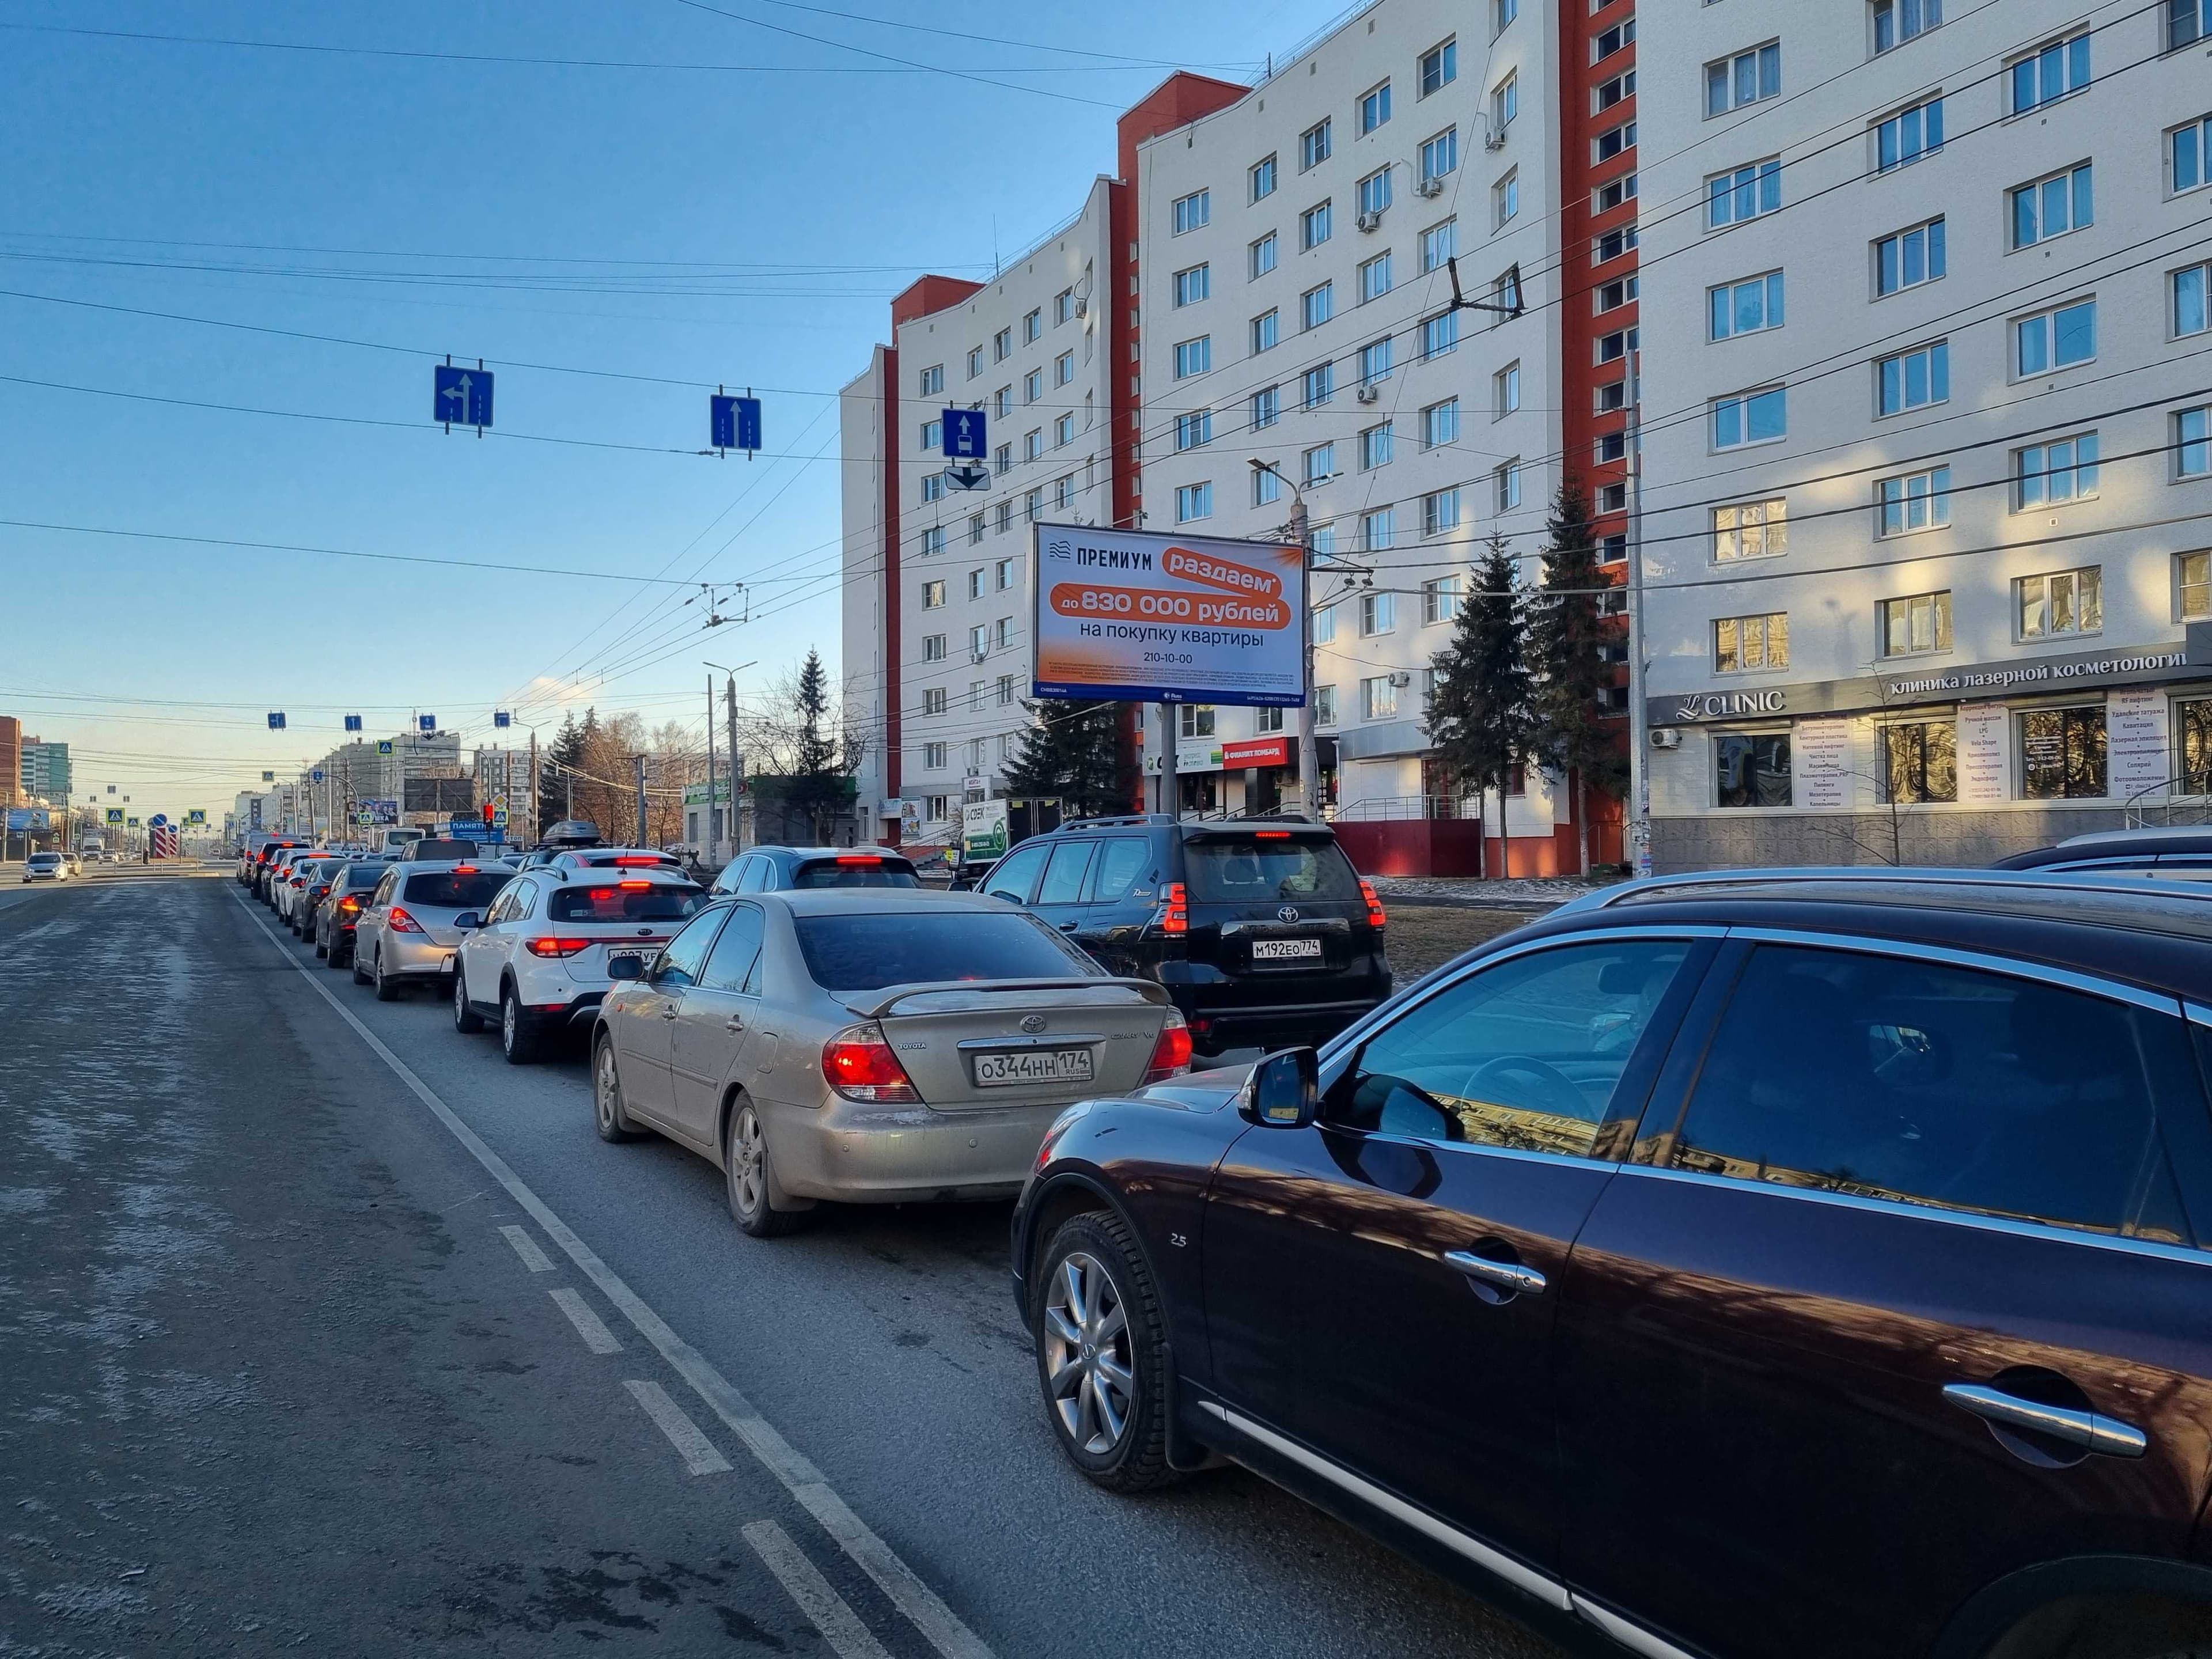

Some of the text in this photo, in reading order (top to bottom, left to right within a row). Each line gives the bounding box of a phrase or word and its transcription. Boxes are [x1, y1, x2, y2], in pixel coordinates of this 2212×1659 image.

[1077, 548, 1152, 571] ПРЕМИУМ
[1061, 591, 1279, 623] до 830 000 рублей
[1081, 623, 1264, 649] на покупку квартиры
[1143, 652, 1193, 664] 210-10-00
[1891, 676, 1960, 695] клиника
[1964, 664, 2048, 687] лазерной
[1705, 691, 1785, 716] CLINIC
[1255, 748, 1280, 756] ЛОМБАРД
[1301, 941, 1319, 951] 774
[898, 1042, 926, 1050] TOYOTA
[1059, 1052, 1089, 1069] 174
[1171, 1233, 1187, 1247] 25
